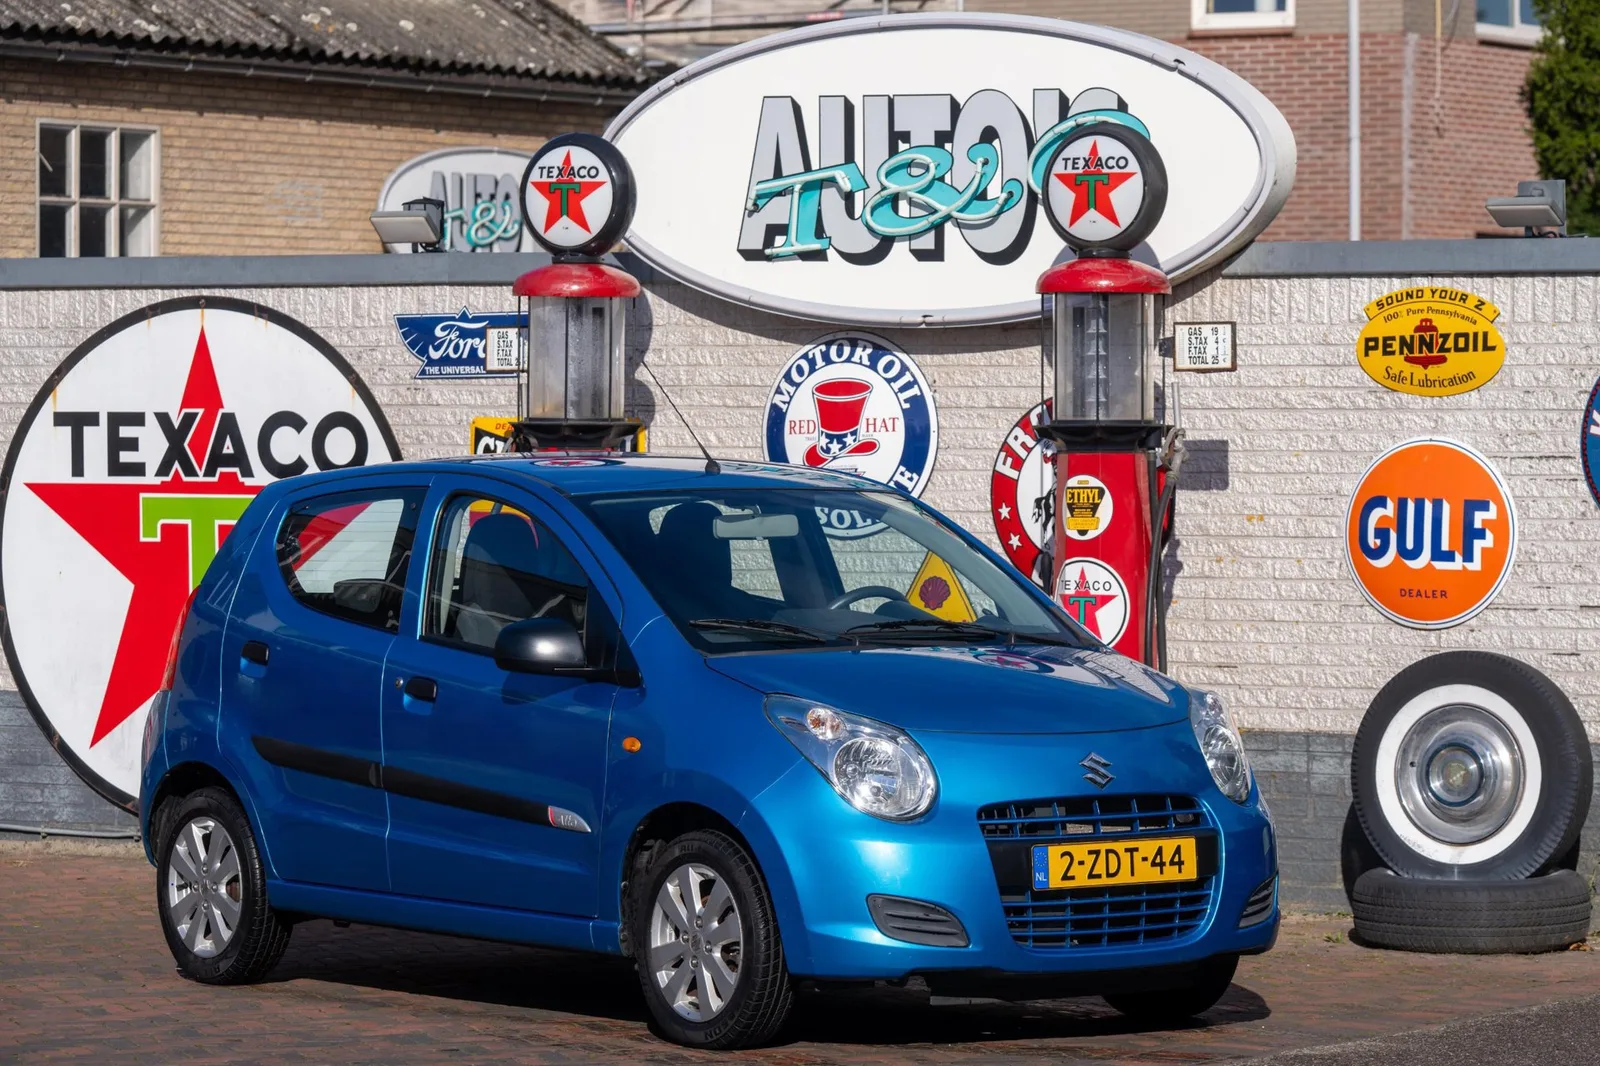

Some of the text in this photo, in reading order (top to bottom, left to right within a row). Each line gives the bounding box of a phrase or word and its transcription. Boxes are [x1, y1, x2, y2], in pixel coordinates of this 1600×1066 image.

[538, 165, 600, 179] TEXACO
[1062, 156, 1129, 170] TEXACO
[549, 181, 581, 217] T
[1075, 173, 1109, 210] T
[1376, 289, 1486, 311] SOUND YOUR Z
[1406, 308, 1425, 316] Pure
[1426, 306, 1477, 325] Pennsylvania
[497, 331, 509, 339] GAS
[1188, 327, 1203, 336] GAS
[1364, 331, 1498, 357] PENNZOIL
[424, 365, 487, 375] THE UNIVERSAL
[1188, 356, 1219, 365] TOTAL 25
[772, 339, 922, 412] MOTOR OIL
[1383, 366, 1476, 388] Safe Lubrication
[788, 417, 899, 435] RED HAT
[53, 410, 369, 479] TEXACO
[1066, 489, 1101, 503] ETHYL
[1359, 495, 1497, 571] GULF
[1400, 588, 1448, 599] DEALER
[1069, 596, 1096, 624] T
[1035, 844, 1185, 881] NL 2-ZDT-44
